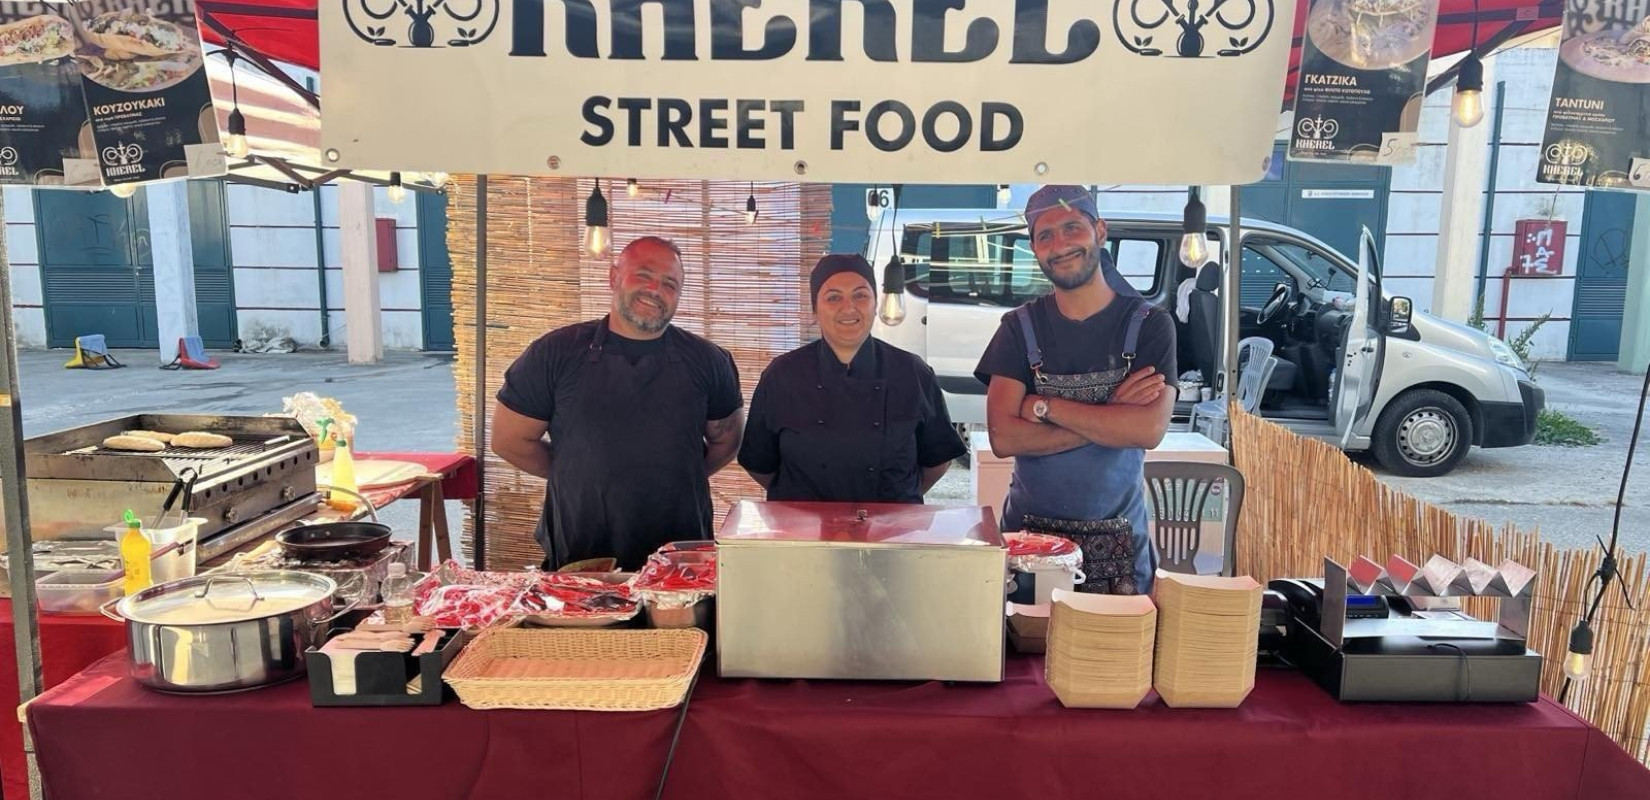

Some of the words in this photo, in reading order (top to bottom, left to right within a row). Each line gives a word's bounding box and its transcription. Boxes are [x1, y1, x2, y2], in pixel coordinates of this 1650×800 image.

[1304, 74, 1357, 86] ΓΚΑΤΖΙΚΑ
[93, 97, 166, 116] ΚΟΥΖΟΥΚΑΚΙ
[1555, 97, 1605, 110] TANTUNI
[580, 95, 804, 149] STREET
[830, 100, 1024, 152] FOOD
